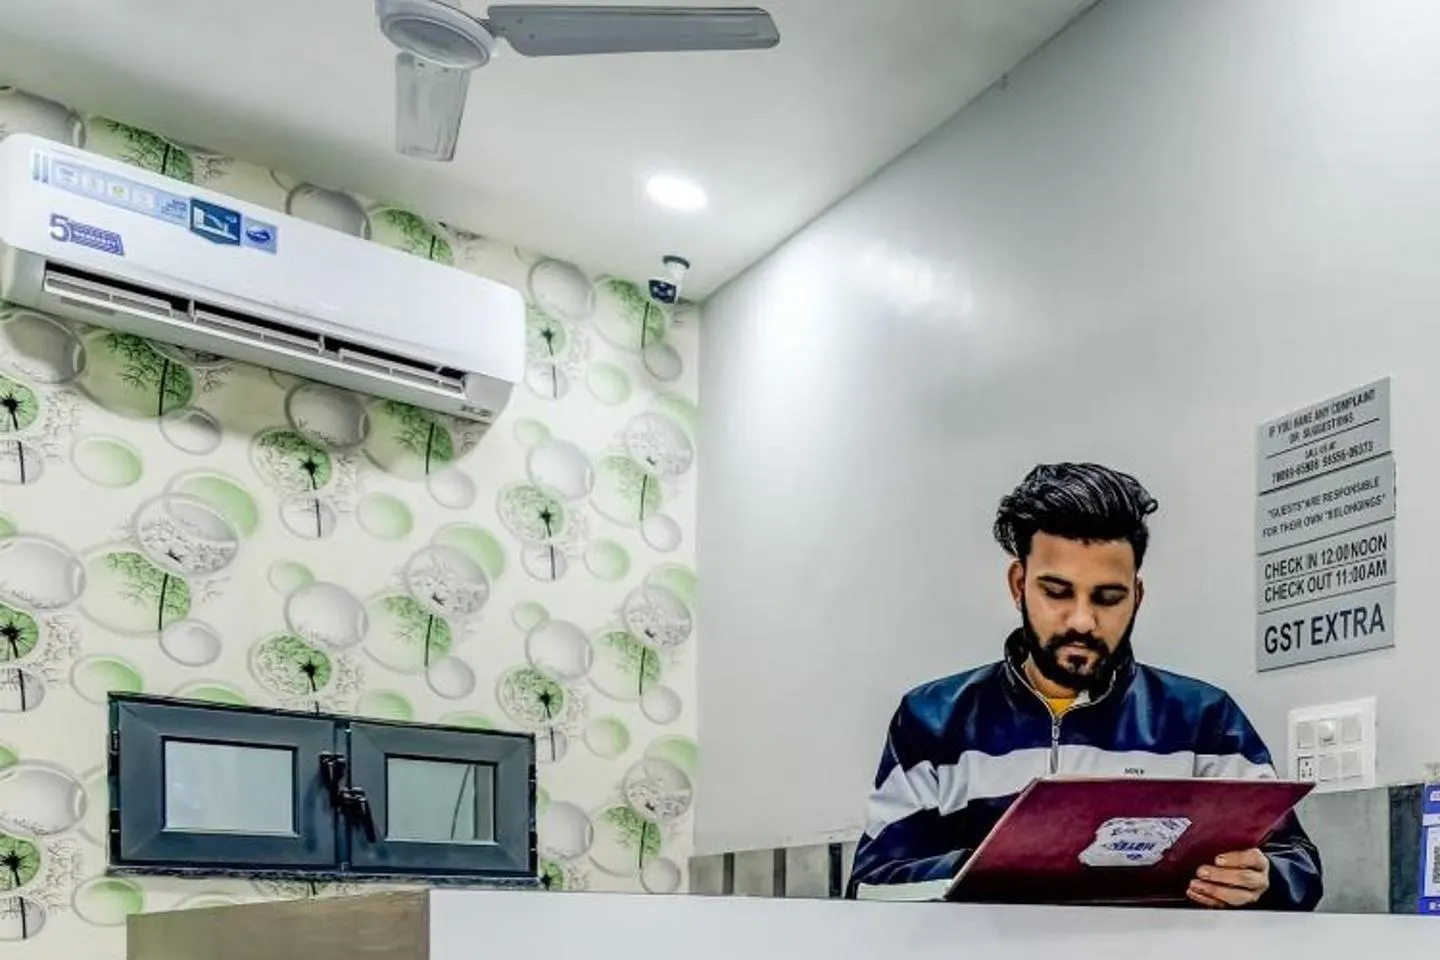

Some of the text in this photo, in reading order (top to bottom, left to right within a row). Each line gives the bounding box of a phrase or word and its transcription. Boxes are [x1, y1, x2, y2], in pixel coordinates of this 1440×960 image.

[1278, 419, 1292, 434] YOU
[1322, 476, 1380, 503] RESPONSIBLE
[1263, 525, 1278, 538] FOR
[1280, 517, 1302, 534] THEIR
[1303, 512, 1324, 527] OWN
[1265, 555, 1303, 579] CHECK
[1305, 552, 1318, 569] IN
[1264, 579, 1304, 603] CHECK
[1307, 572, 1333, 593] OUT
[1264, 602, 1386, 654] GST EXTRA
